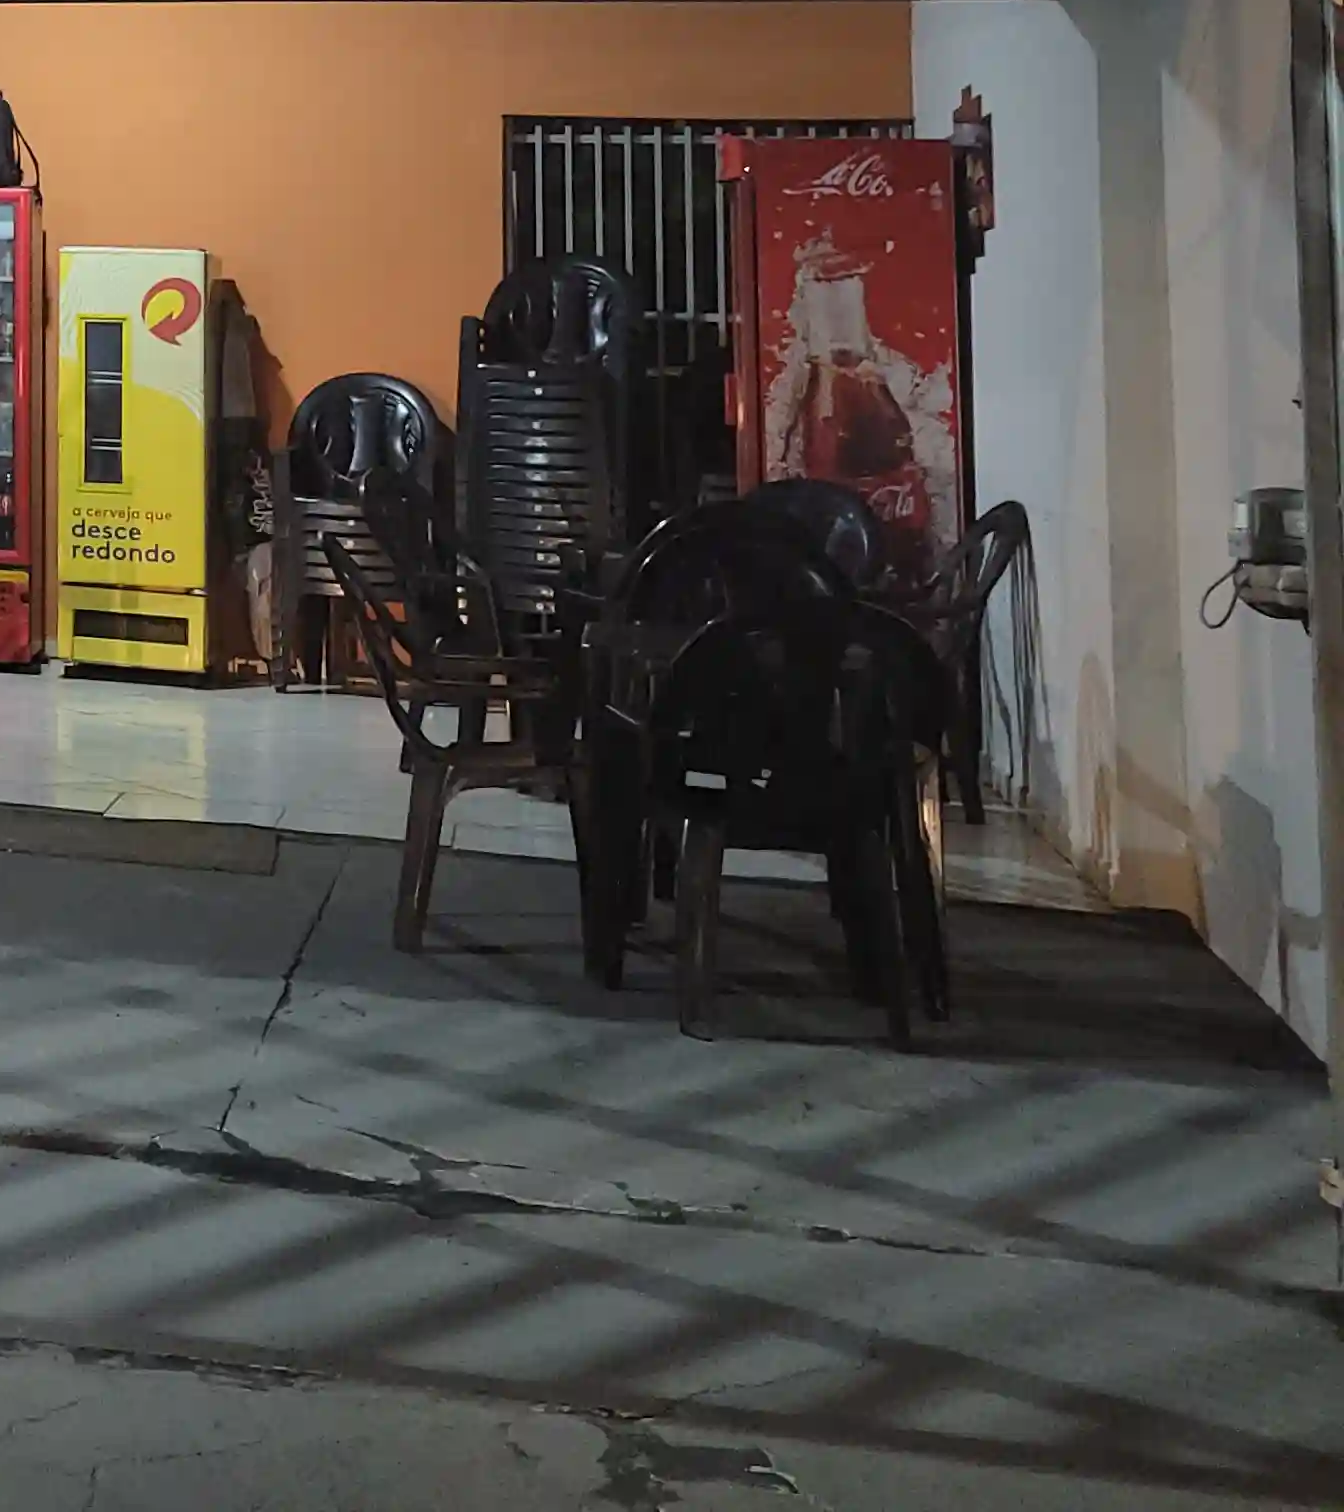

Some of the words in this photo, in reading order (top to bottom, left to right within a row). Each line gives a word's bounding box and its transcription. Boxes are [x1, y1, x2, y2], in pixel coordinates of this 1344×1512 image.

[72, 507, 82, 517] a
[86, 506, 141, 523] cerveja
[145, 510, 173, 524] que
[72, 518, 141, 541] desce
[72, 540, 176, 564] redondo
